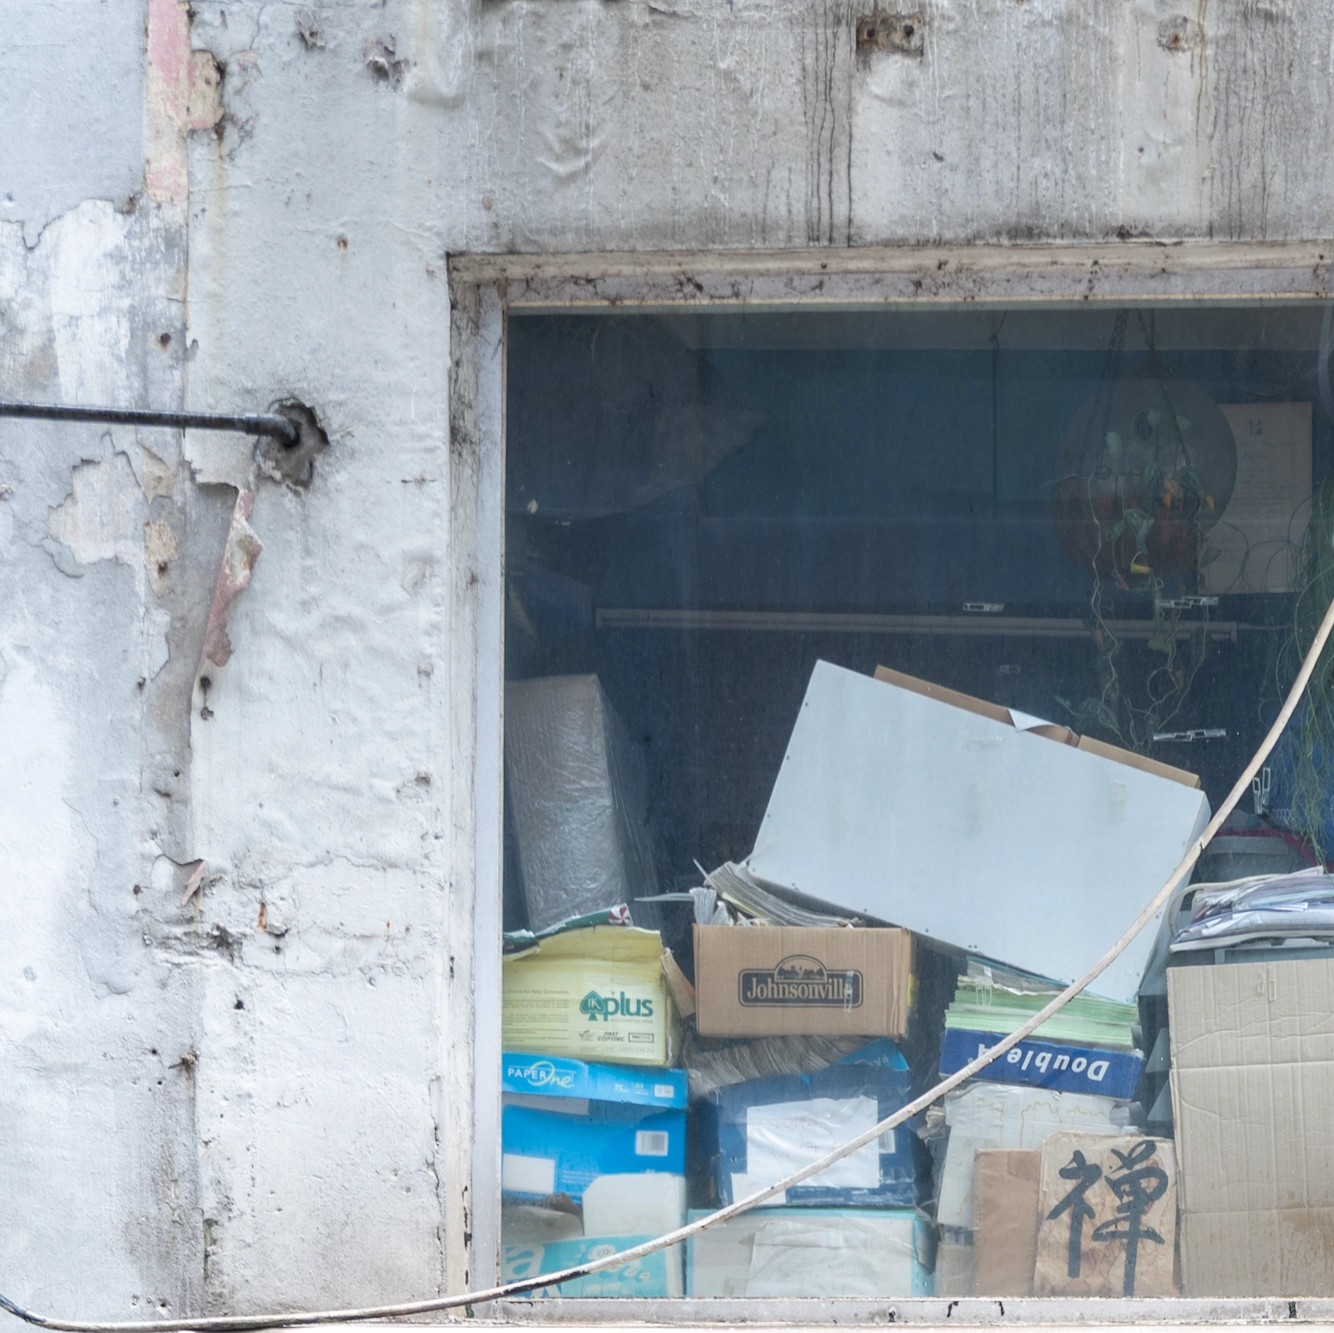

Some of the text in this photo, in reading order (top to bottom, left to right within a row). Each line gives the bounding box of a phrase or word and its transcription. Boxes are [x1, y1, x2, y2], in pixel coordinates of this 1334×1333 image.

[748, 977, 854, 1001] Johnsonville
[603, 991, 654, 1022] plus
[1006, 1048, 1110, 1081] Double
